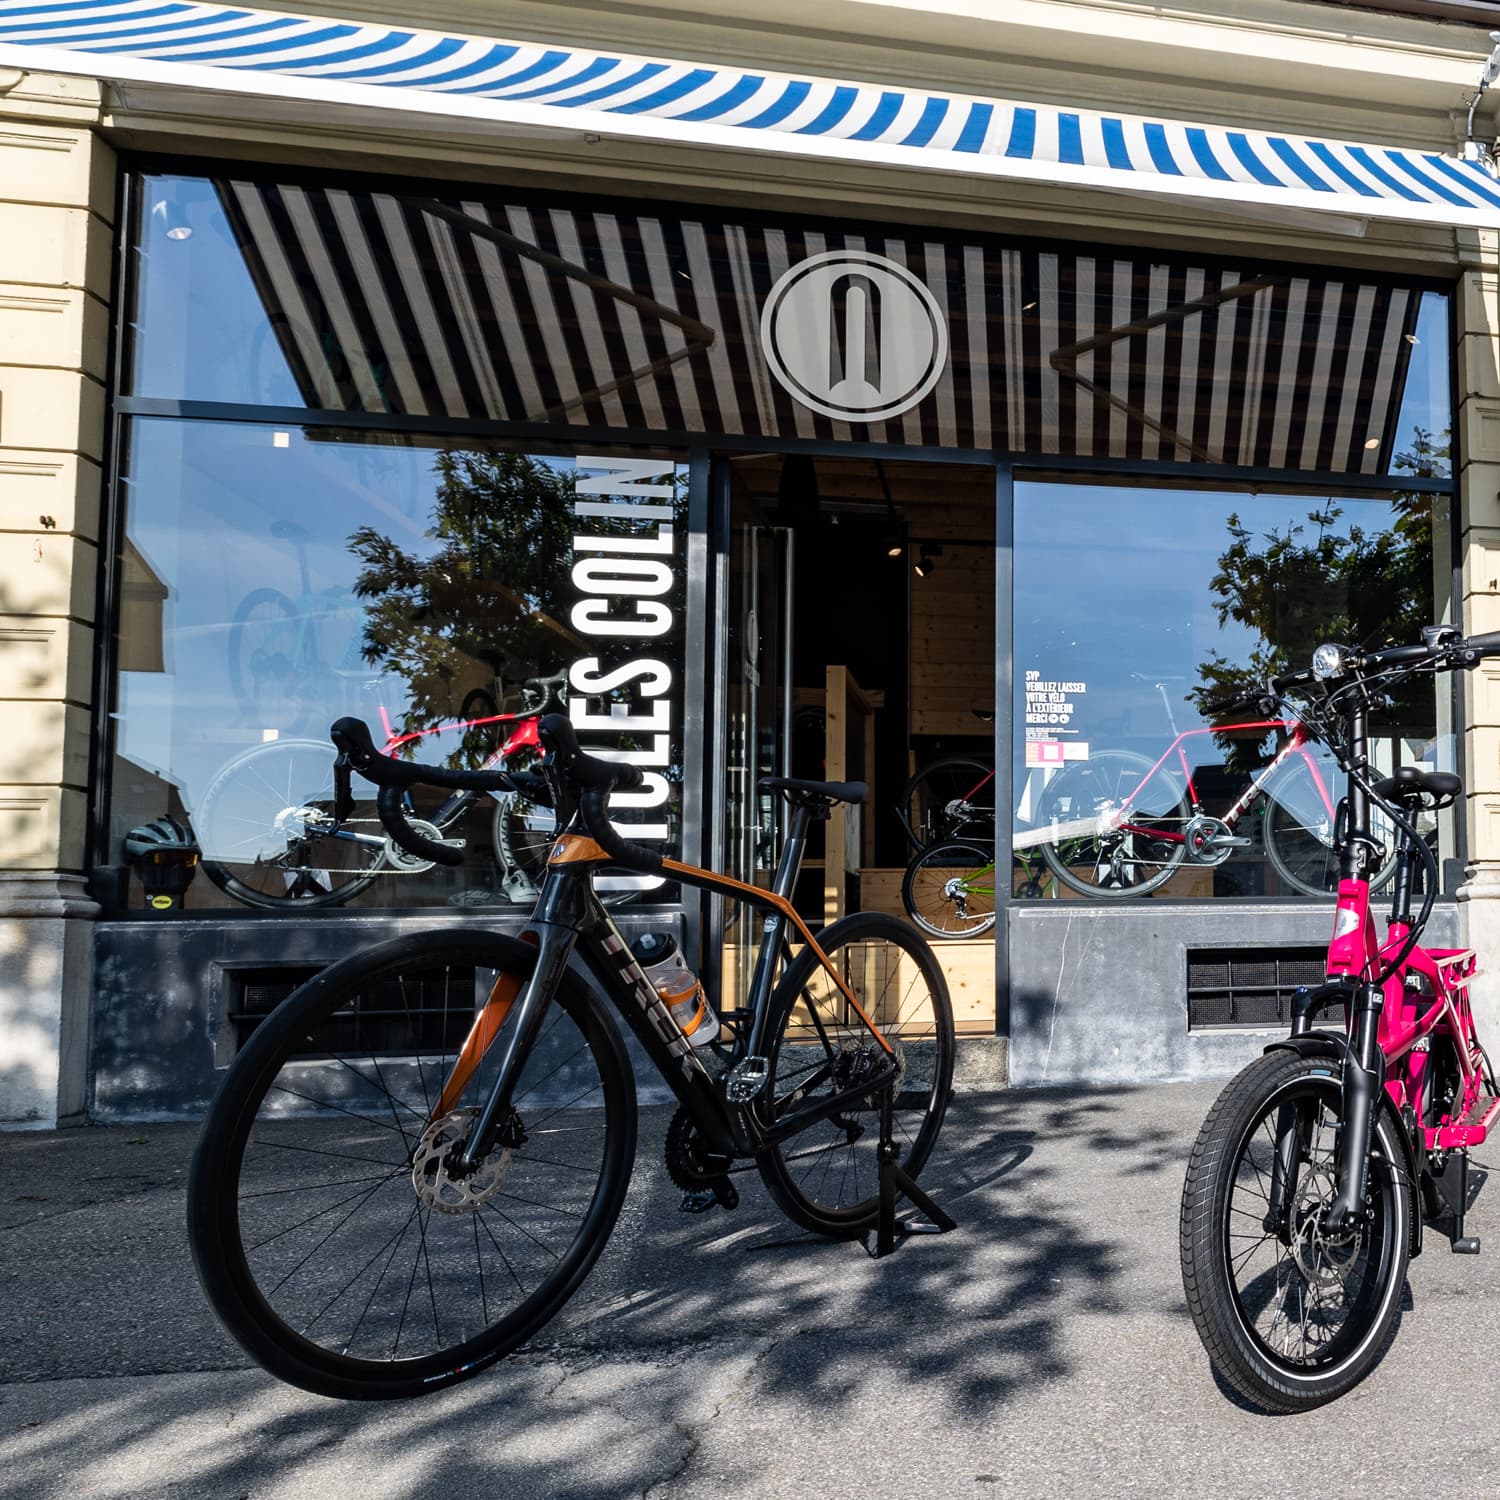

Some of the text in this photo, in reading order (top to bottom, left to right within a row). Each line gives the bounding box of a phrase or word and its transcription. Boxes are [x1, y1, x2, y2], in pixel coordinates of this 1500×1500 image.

[571, 455, 674, 636] COLIN
[1025, 671, 1040, 681] SVP
[1026, 682, 1086, 693] VEUILLEZ LAISSER
[1026, 692, 1048, 702] VOTRE
[1026, 713, 1048, 723] MERCI
[1222, 749, 1288, 822] TREK
[601, 934, 708, 1083] TREK
